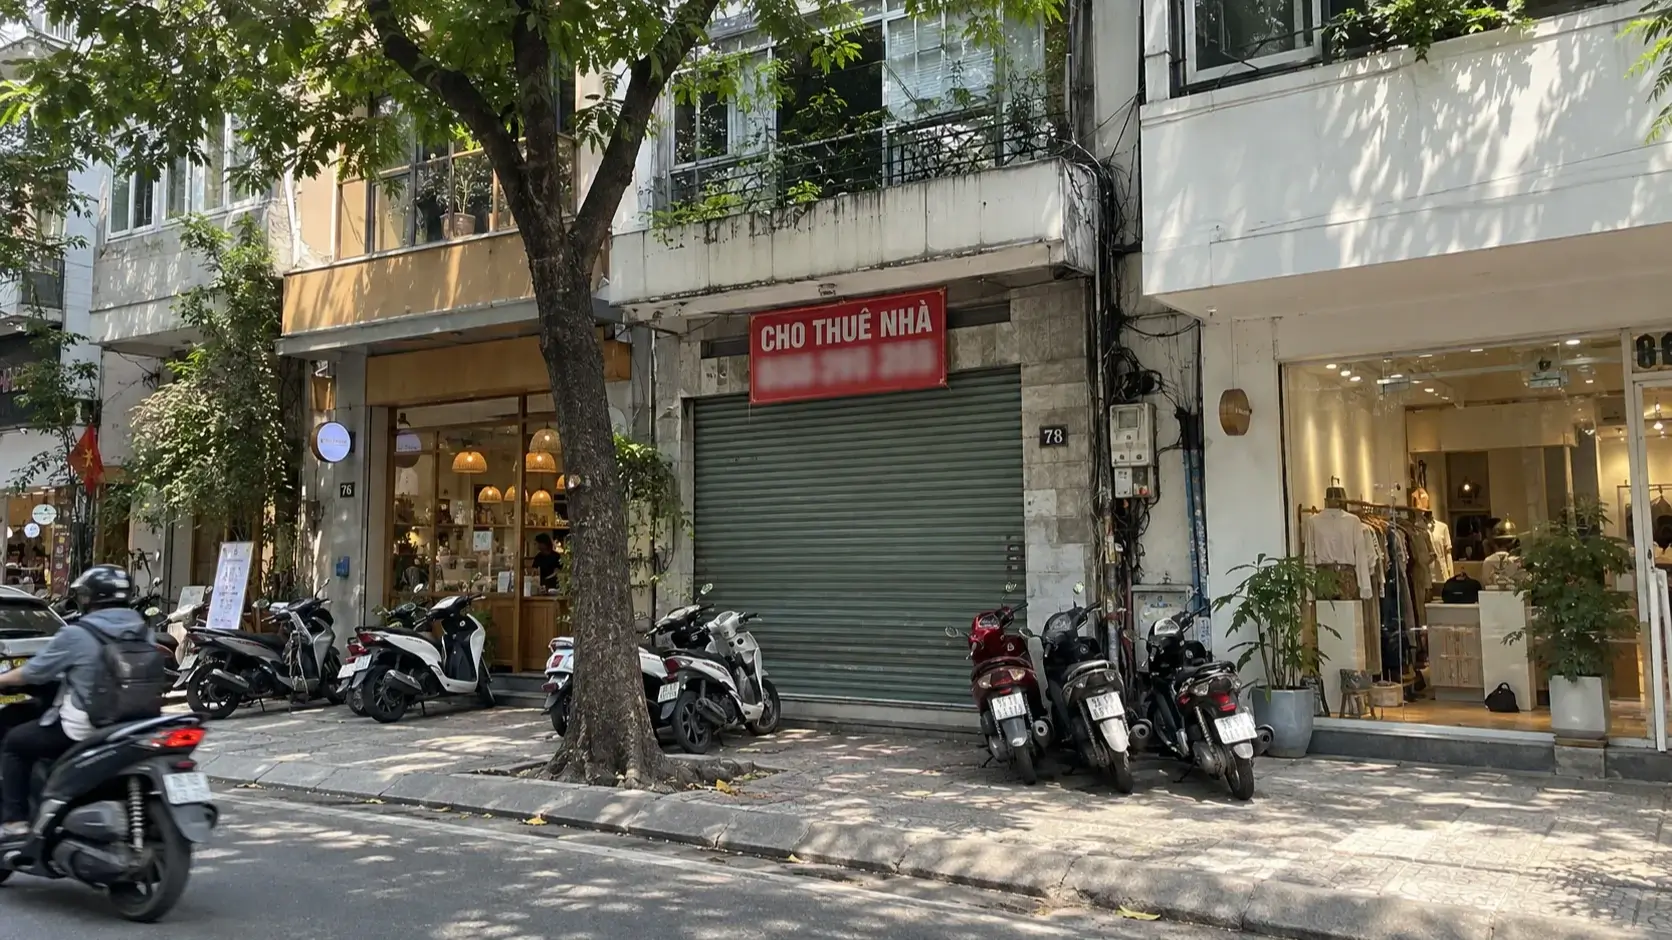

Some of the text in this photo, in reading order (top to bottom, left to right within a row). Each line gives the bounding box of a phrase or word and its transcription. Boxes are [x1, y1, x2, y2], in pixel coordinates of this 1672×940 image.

[761, 300, 932, 352] CHO THUÊ NHÀ
[1044, 429, 1063, 444] 78
[341, 485, 352, 495] 76
